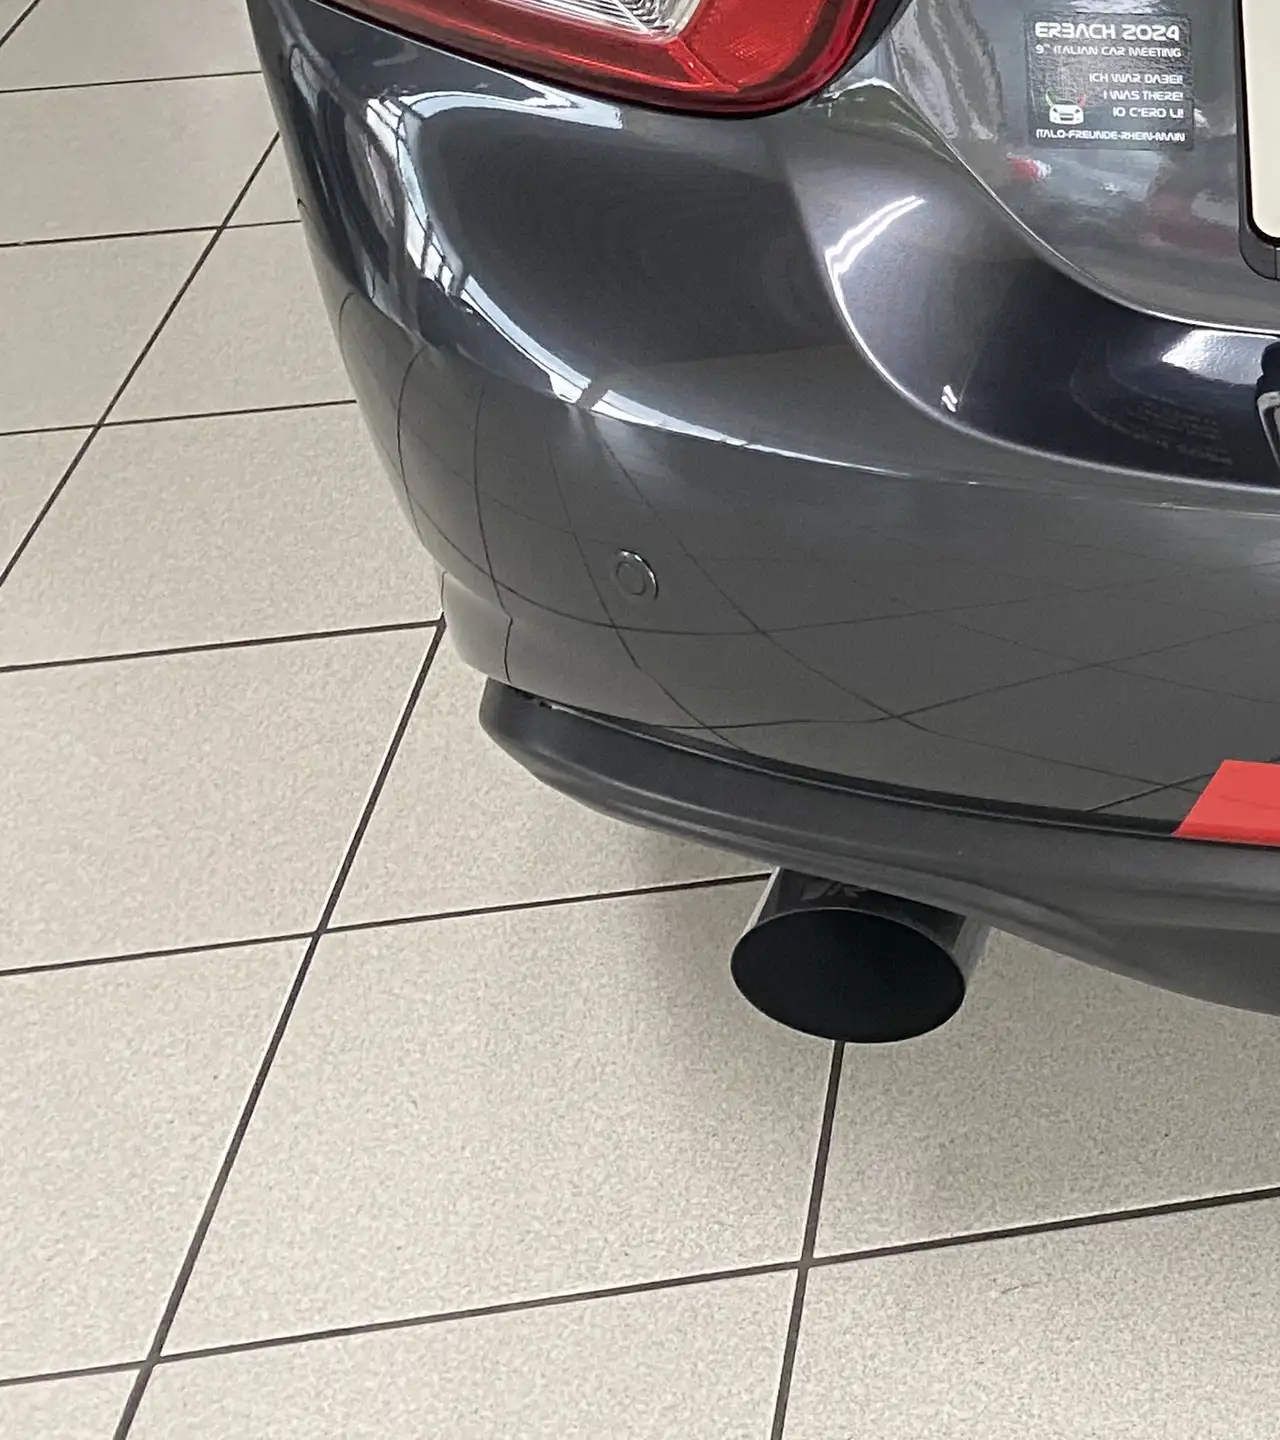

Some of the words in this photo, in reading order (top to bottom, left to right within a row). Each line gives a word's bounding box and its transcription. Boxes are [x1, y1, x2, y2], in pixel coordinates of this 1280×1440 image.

[1035, 22, 1116, 40] ERBACH
[1121, 24, 1180, 42] 2024
[1053, 45, 1098, 55] ITALIAN
[1101, 46, 1125, 57] CAR
[1128, 47, 1182, 58] MEETING
[1089, 73, 1109, 83] ICH
[1111, 73, 1141, 83] WAR
[1103, 90, 1107, 100] I
[1109, 91, 1140, 101] WAS
[1143, 92, 1184, 102] THERE!
